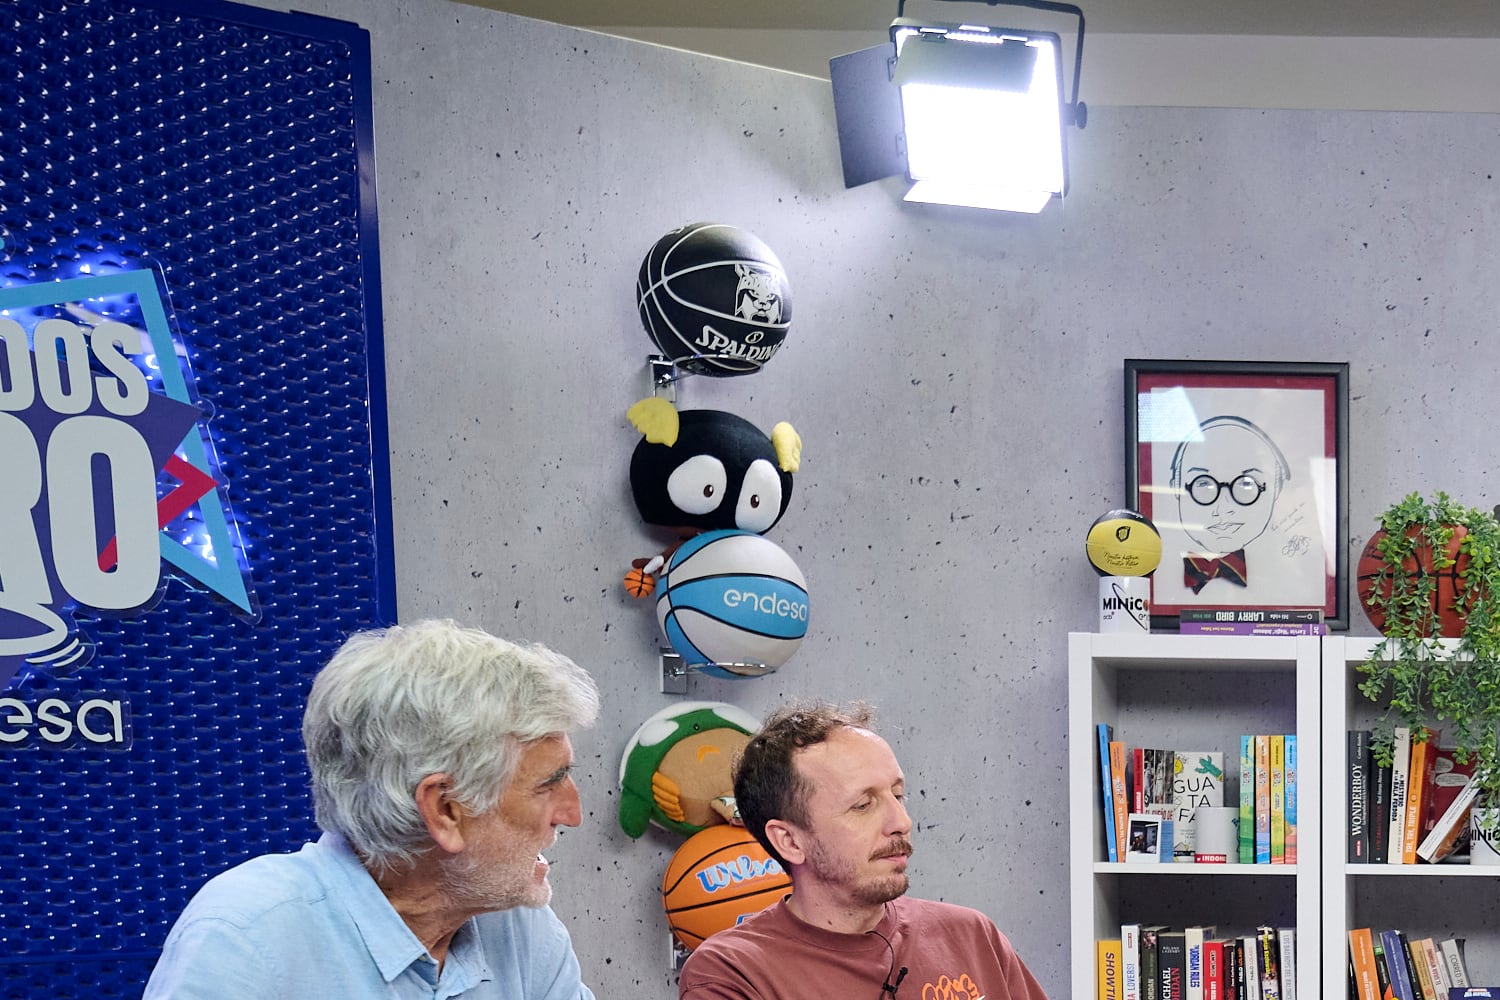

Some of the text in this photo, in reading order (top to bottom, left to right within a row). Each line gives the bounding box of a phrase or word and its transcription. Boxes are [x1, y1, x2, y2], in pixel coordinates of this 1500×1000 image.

[695, 325, 785, 361] SPALDIN
[723, 589, 808, 622] endesa
[1215, 611, 1235, 621] BIRD
[1238, 611, 1264, 622] LARRY
[0, 698, 124, 742] esa
[1174, 776, 1215, 794] GUA
[1188, 794, 1211, 808] TA
[1352, 763, 1362, 836] WONDERBOY
[696, 855, 786, 893] Wilso
